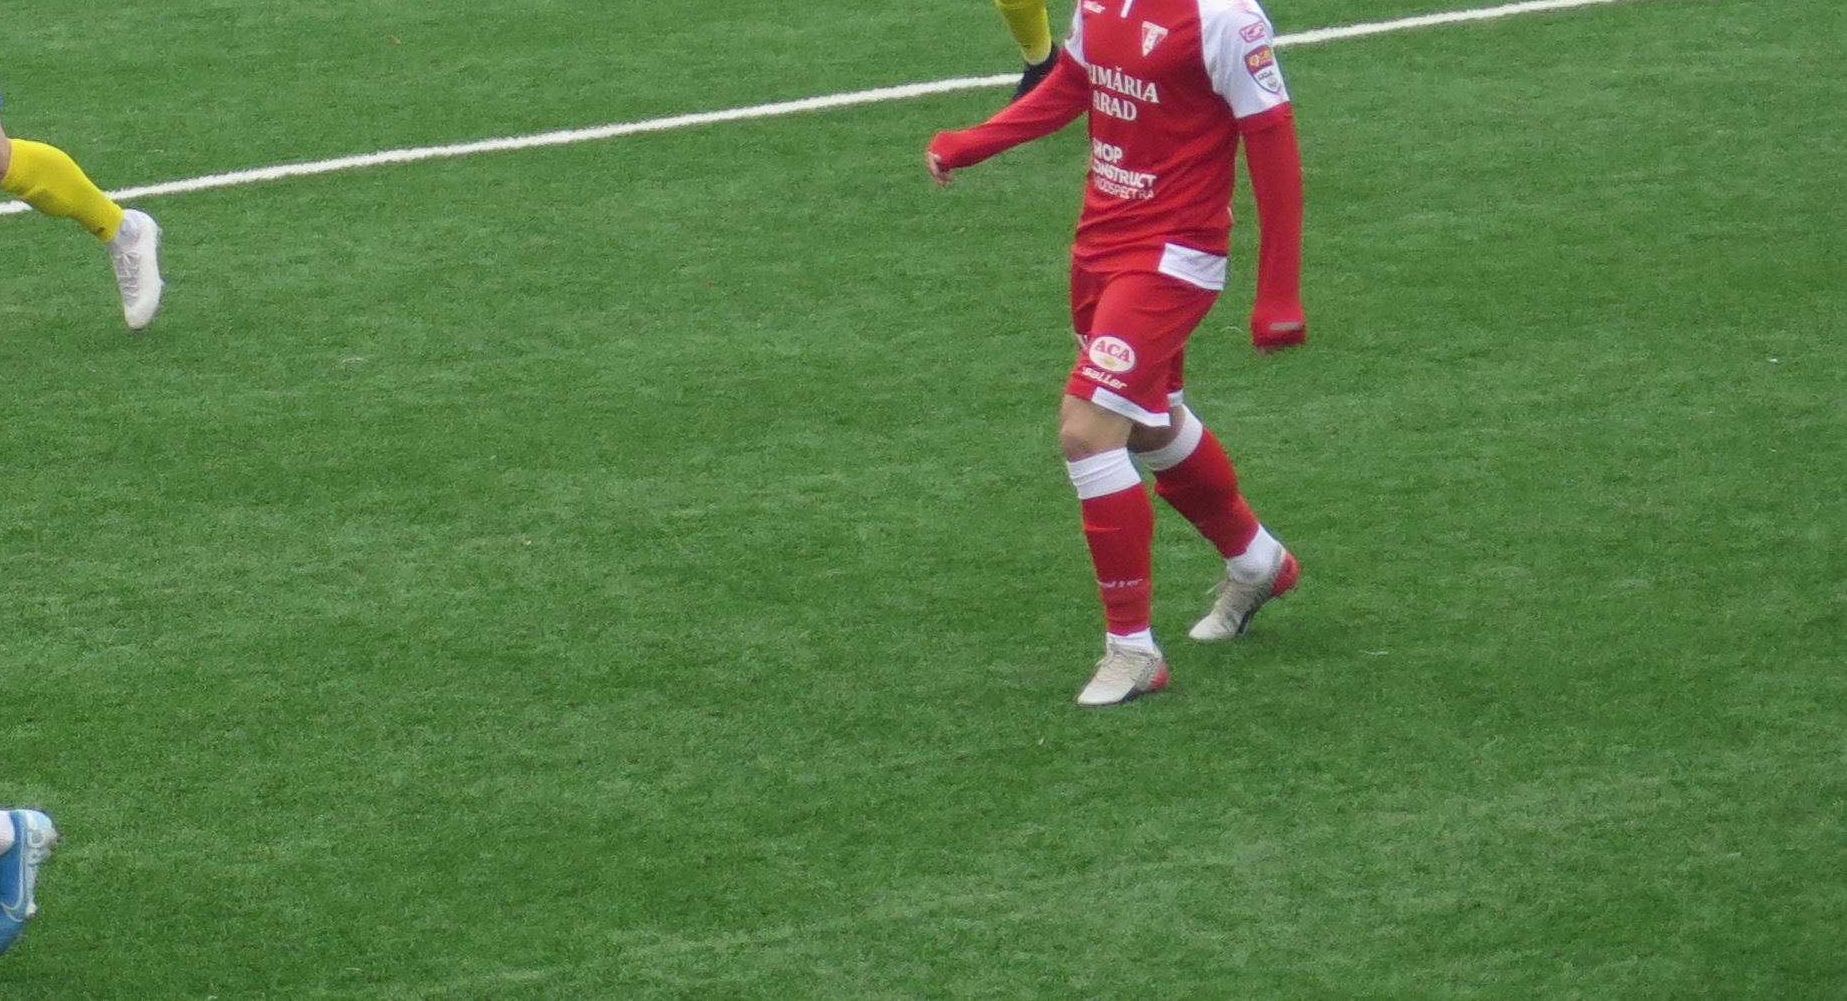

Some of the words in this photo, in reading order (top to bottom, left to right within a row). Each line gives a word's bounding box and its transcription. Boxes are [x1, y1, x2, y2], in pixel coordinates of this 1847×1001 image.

[1088, 64, 1160, 104] IMĂRIA
[1093, 90, 1137, 121] ARAD
[1092, 158, 1157, 188] ONSTRUCT
[1094, 340, 1131, 363] ACA
[1082, 366, 1128, 389] saller
